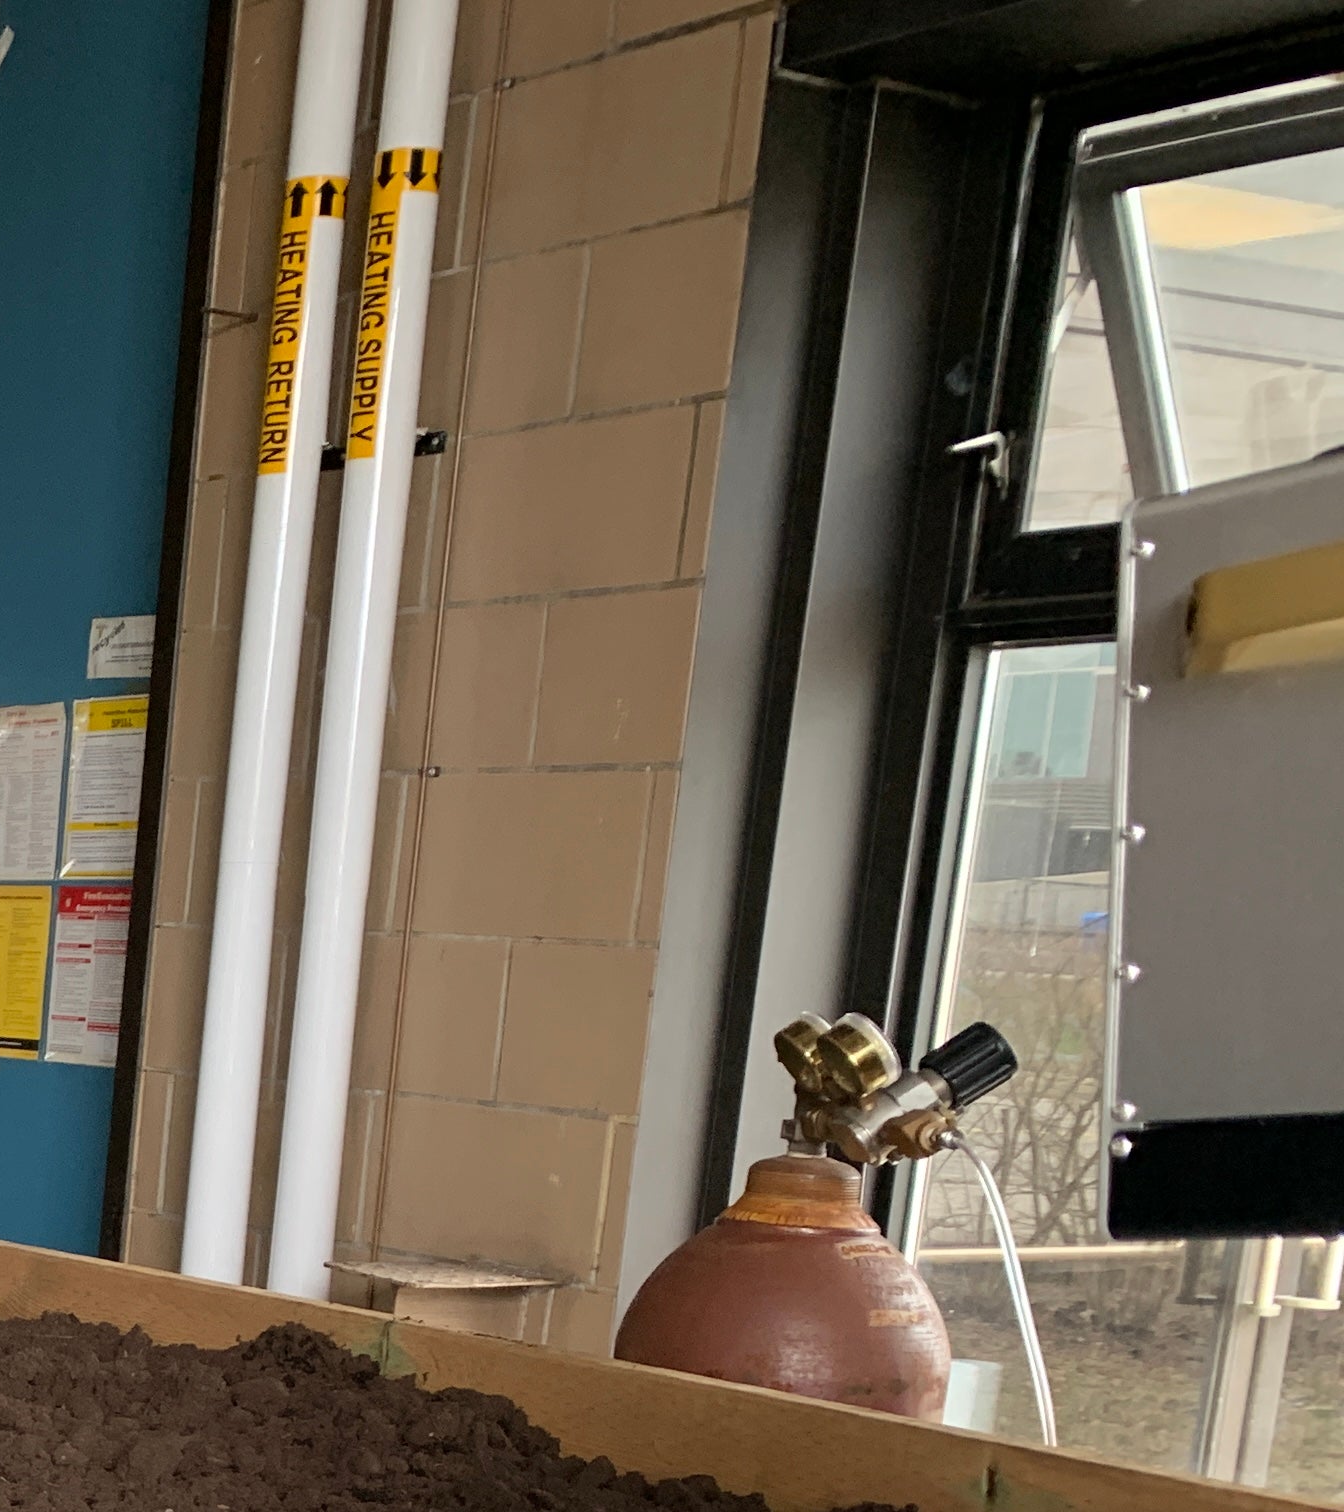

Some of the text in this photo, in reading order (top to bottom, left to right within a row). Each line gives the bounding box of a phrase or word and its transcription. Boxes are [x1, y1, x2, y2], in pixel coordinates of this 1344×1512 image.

[259, 229, 307, 466] HEATING RETURN
[349, 210, 395, 442] HEATING SUPPLY
